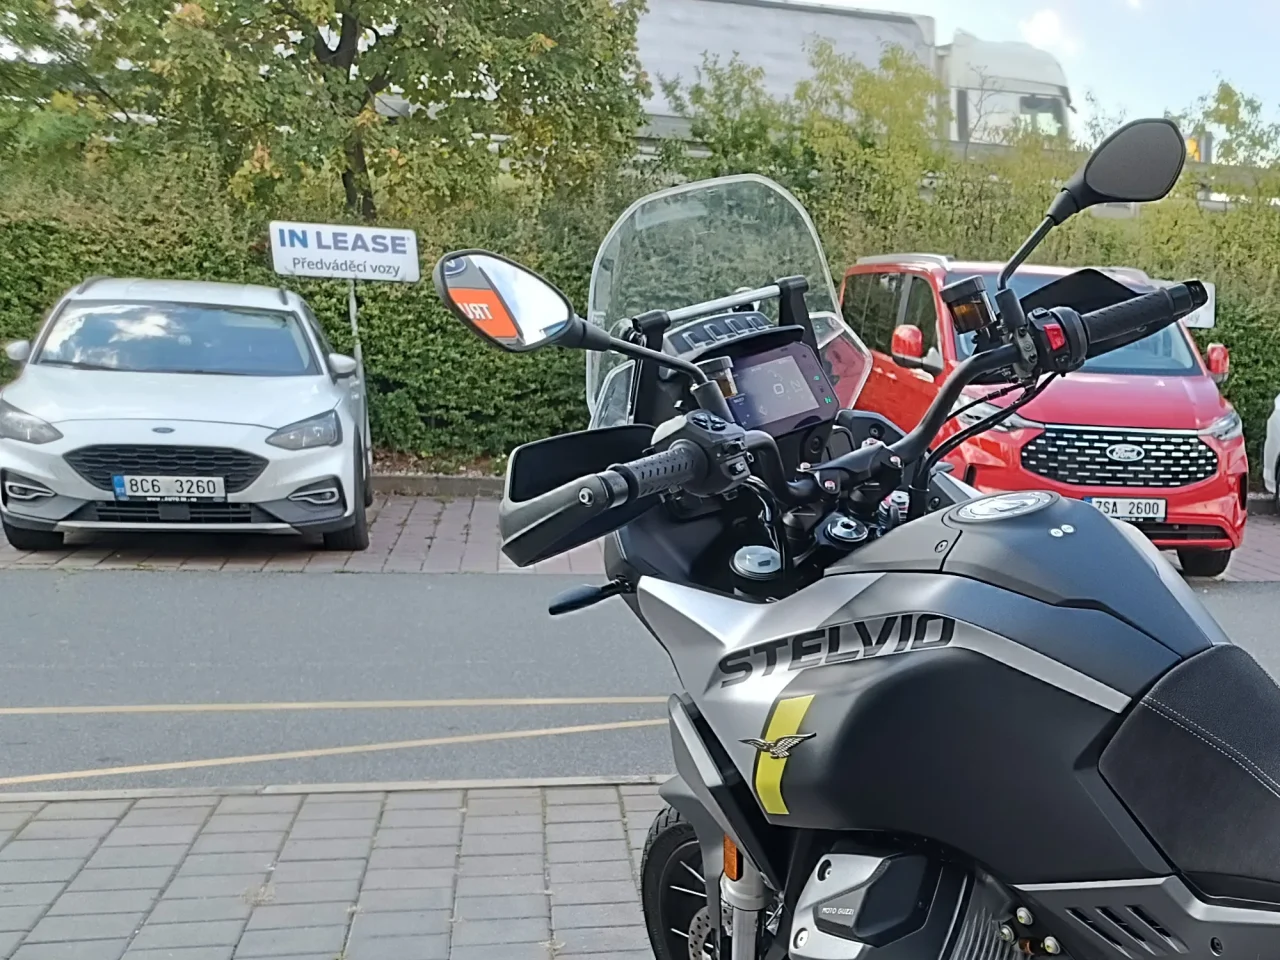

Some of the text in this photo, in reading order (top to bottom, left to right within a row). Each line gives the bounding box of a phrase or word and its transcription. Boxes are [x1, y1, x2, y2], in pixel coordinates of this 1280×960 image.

[278, 228, 408, 255] IN LEASE
[292, 257, 401, 278] Předváděcí vozy
[129, 478, 217, 494] 8C6 3260
[1096, 501, 1160, 515] 7SA 2600
[718, 613, 956, 689] STELVIO
[821, 907, 855, 916] MOTO GUZZI
